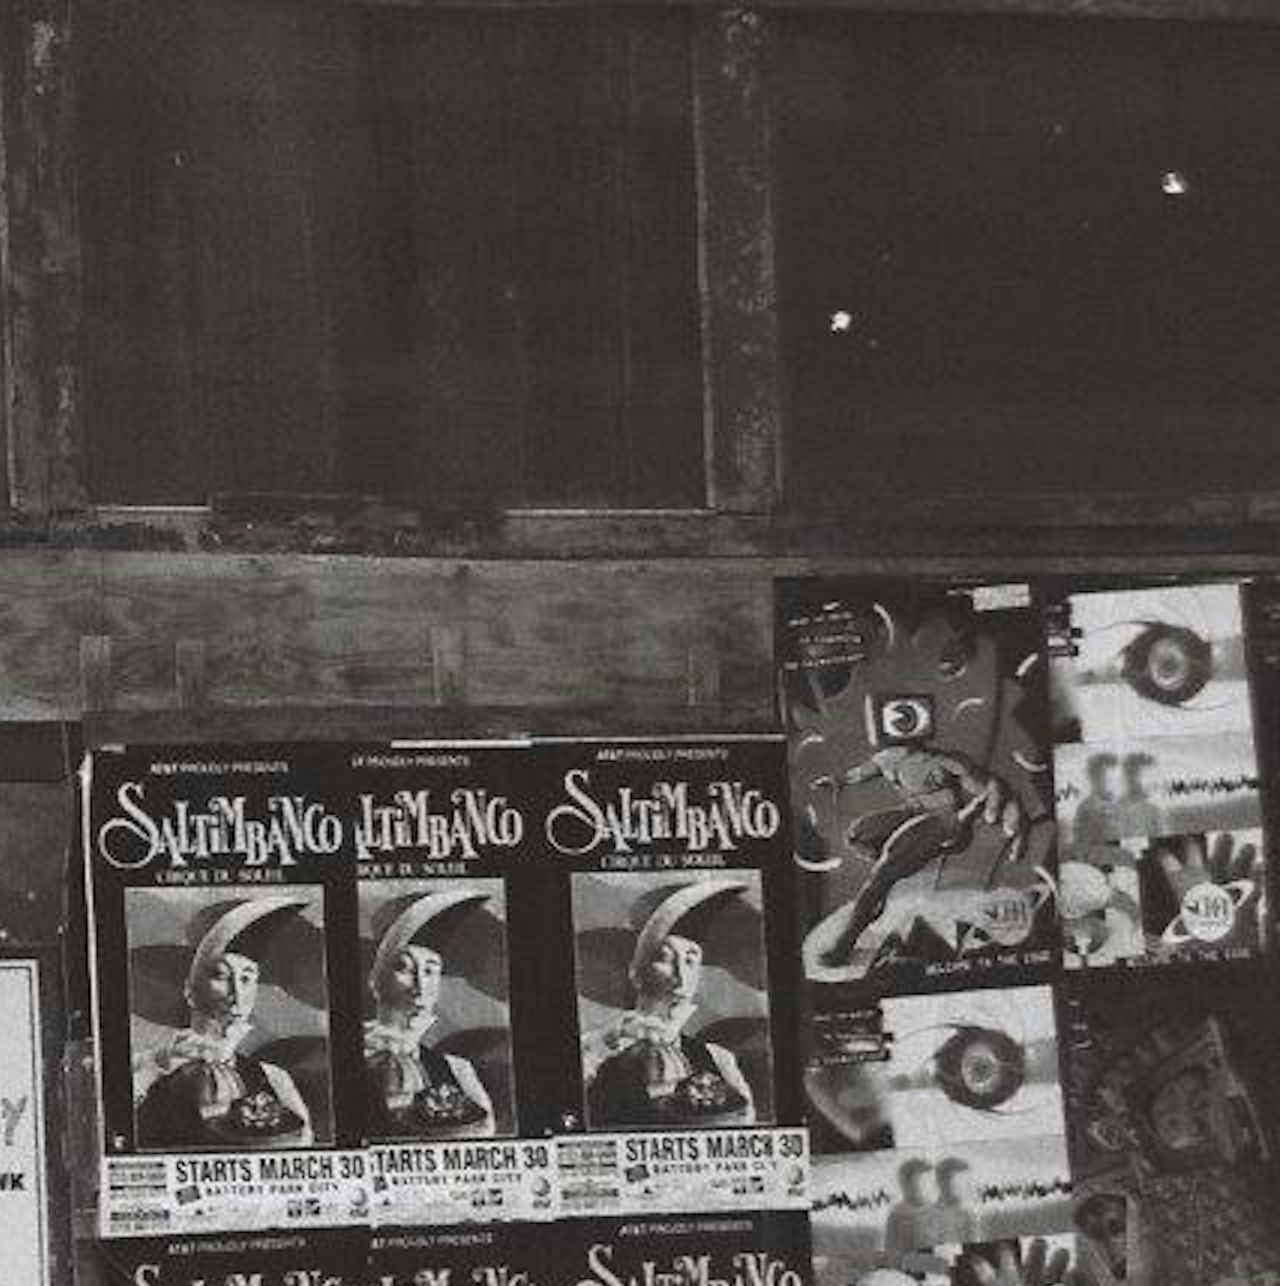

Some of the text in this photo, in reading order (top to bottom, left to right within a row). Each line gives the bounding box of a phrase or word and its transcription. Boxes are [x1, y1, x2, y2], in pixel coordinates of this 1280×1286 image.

[371, 1145, 549, 1173] TARTS MARCH 30
[625, 1133, 803, 1162] STARTS MARCH 30
[176, 1155, 365, 1184] STARTS MARCH 30
